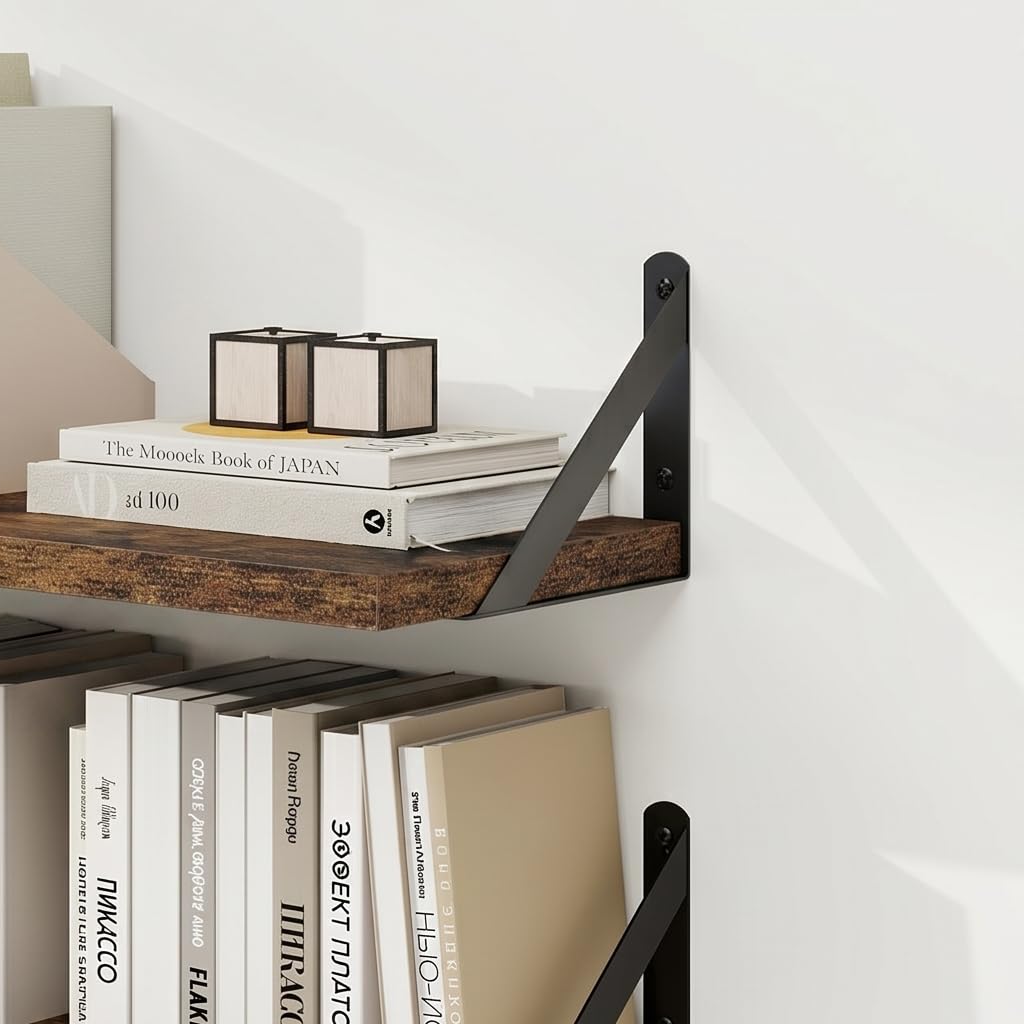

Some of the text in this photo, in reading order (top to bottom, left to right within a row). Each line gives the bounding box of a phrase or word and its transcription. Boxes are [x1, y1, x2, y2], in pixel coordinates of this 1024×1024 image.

[103, 440, 134, 457] The
[211, 450, 253, 469] Book
[257, 454, 276, 471] of
[278, 456, 340, 476] JAPAN
[148, 490, 180, 512] 100
[96, 876, 118, 985] ПИКАССО
